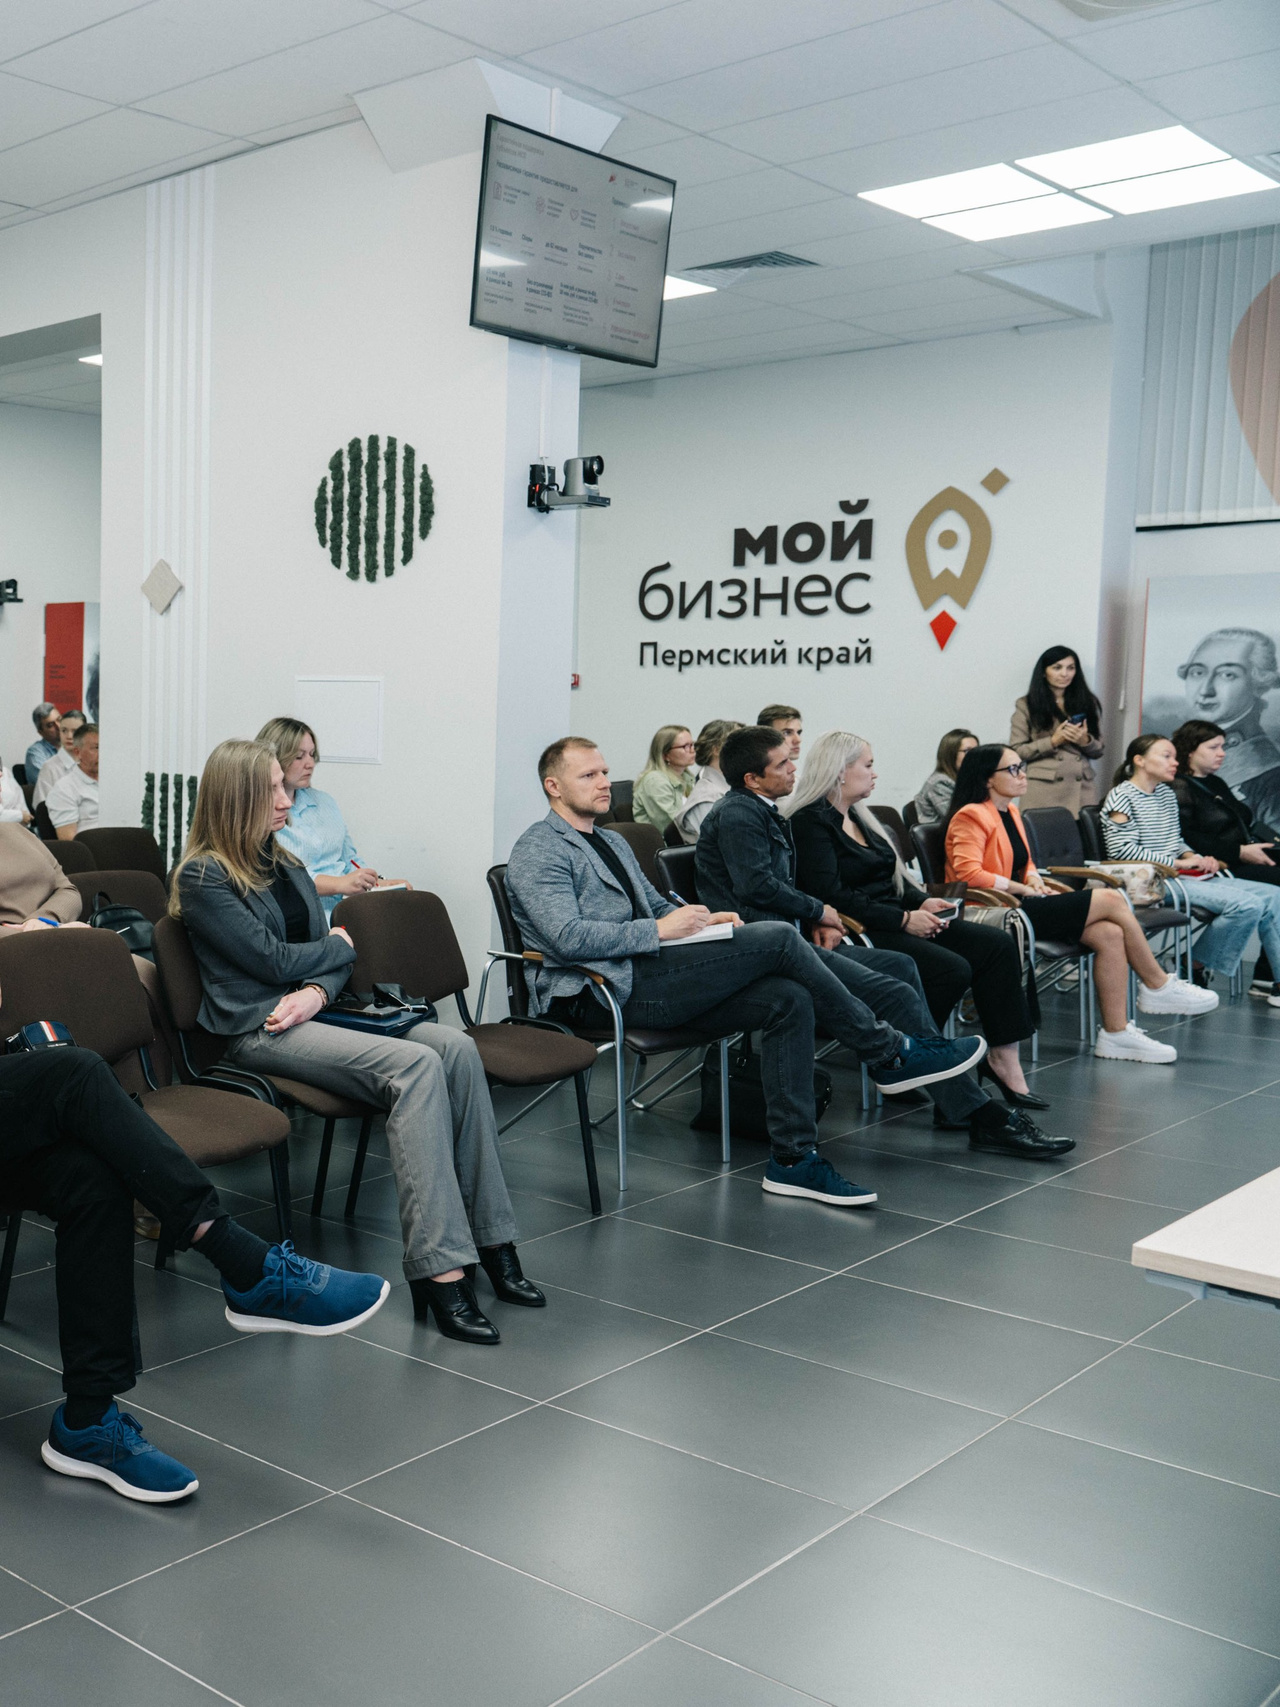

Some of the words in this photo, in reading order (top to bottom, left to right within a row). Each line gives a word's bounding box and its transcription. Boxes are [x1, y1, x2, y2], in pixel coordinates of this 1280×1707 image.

[733, 498, 873, 567] мой
[638, 561, 871, 621] бизнес
[639, 639, 787, 673] Пермский
[798, 638, 872, 671] край
